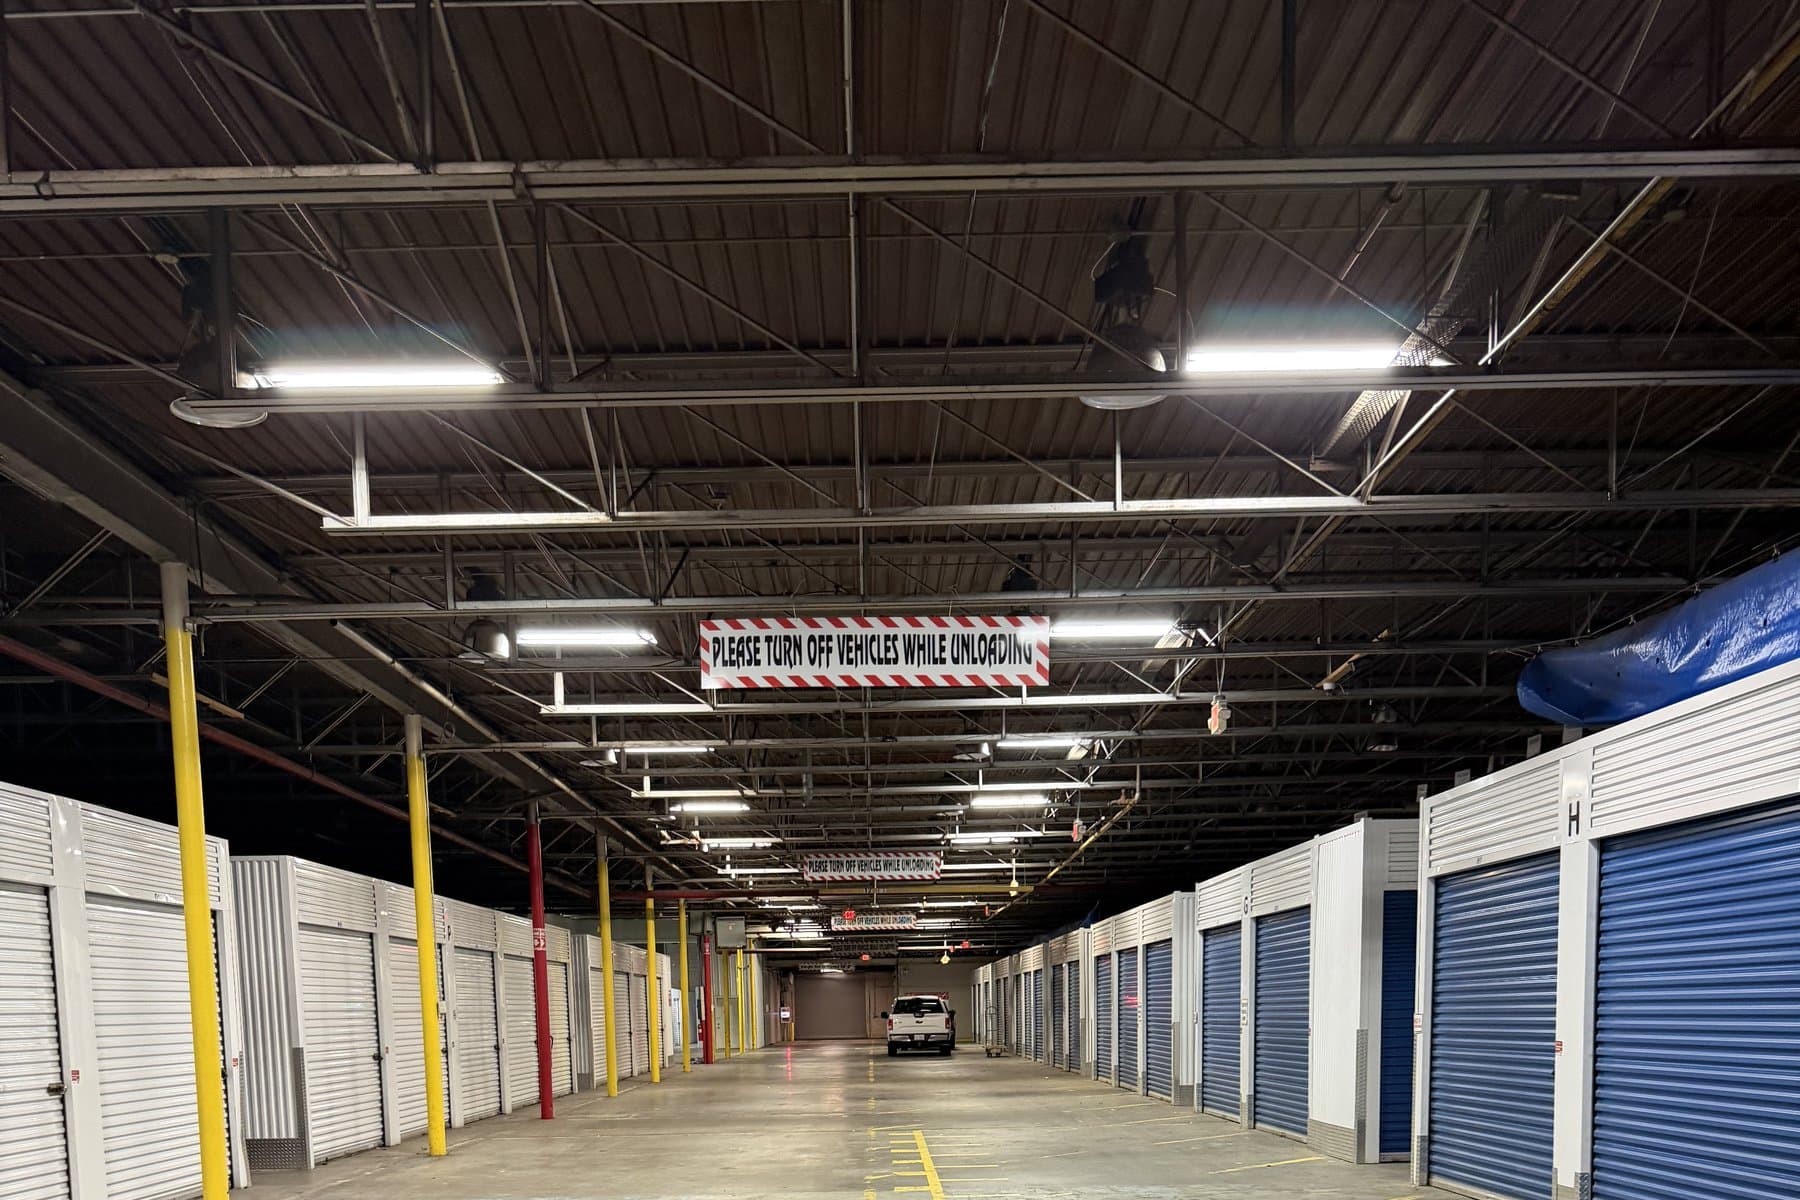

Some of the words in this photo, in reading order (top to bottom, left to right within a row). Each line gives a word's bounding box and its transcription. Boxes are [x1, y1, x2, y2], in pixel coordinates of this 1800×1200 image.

[712, 635, 761, 669] PLEASE
[765, 634, 802, 669] TURN
[807, 634, 833, 669] OFF
[837, 634, 898, 669] VEHICLES
[903, 633, 946, 668] WHILE
[951, 633, 1032, 668] UNLOADING
[1568, 800, 1580, 837] H
[809, 860, 828, 872] PLEASE
[829, 859, 845, 873] TURN
[846, 859, 857, 872] OFF
[857, 859, 881, 872] VEHICLES
[883, 858, 900, 872] WHILE
[901, 858, 934, 871] UNLOADING
